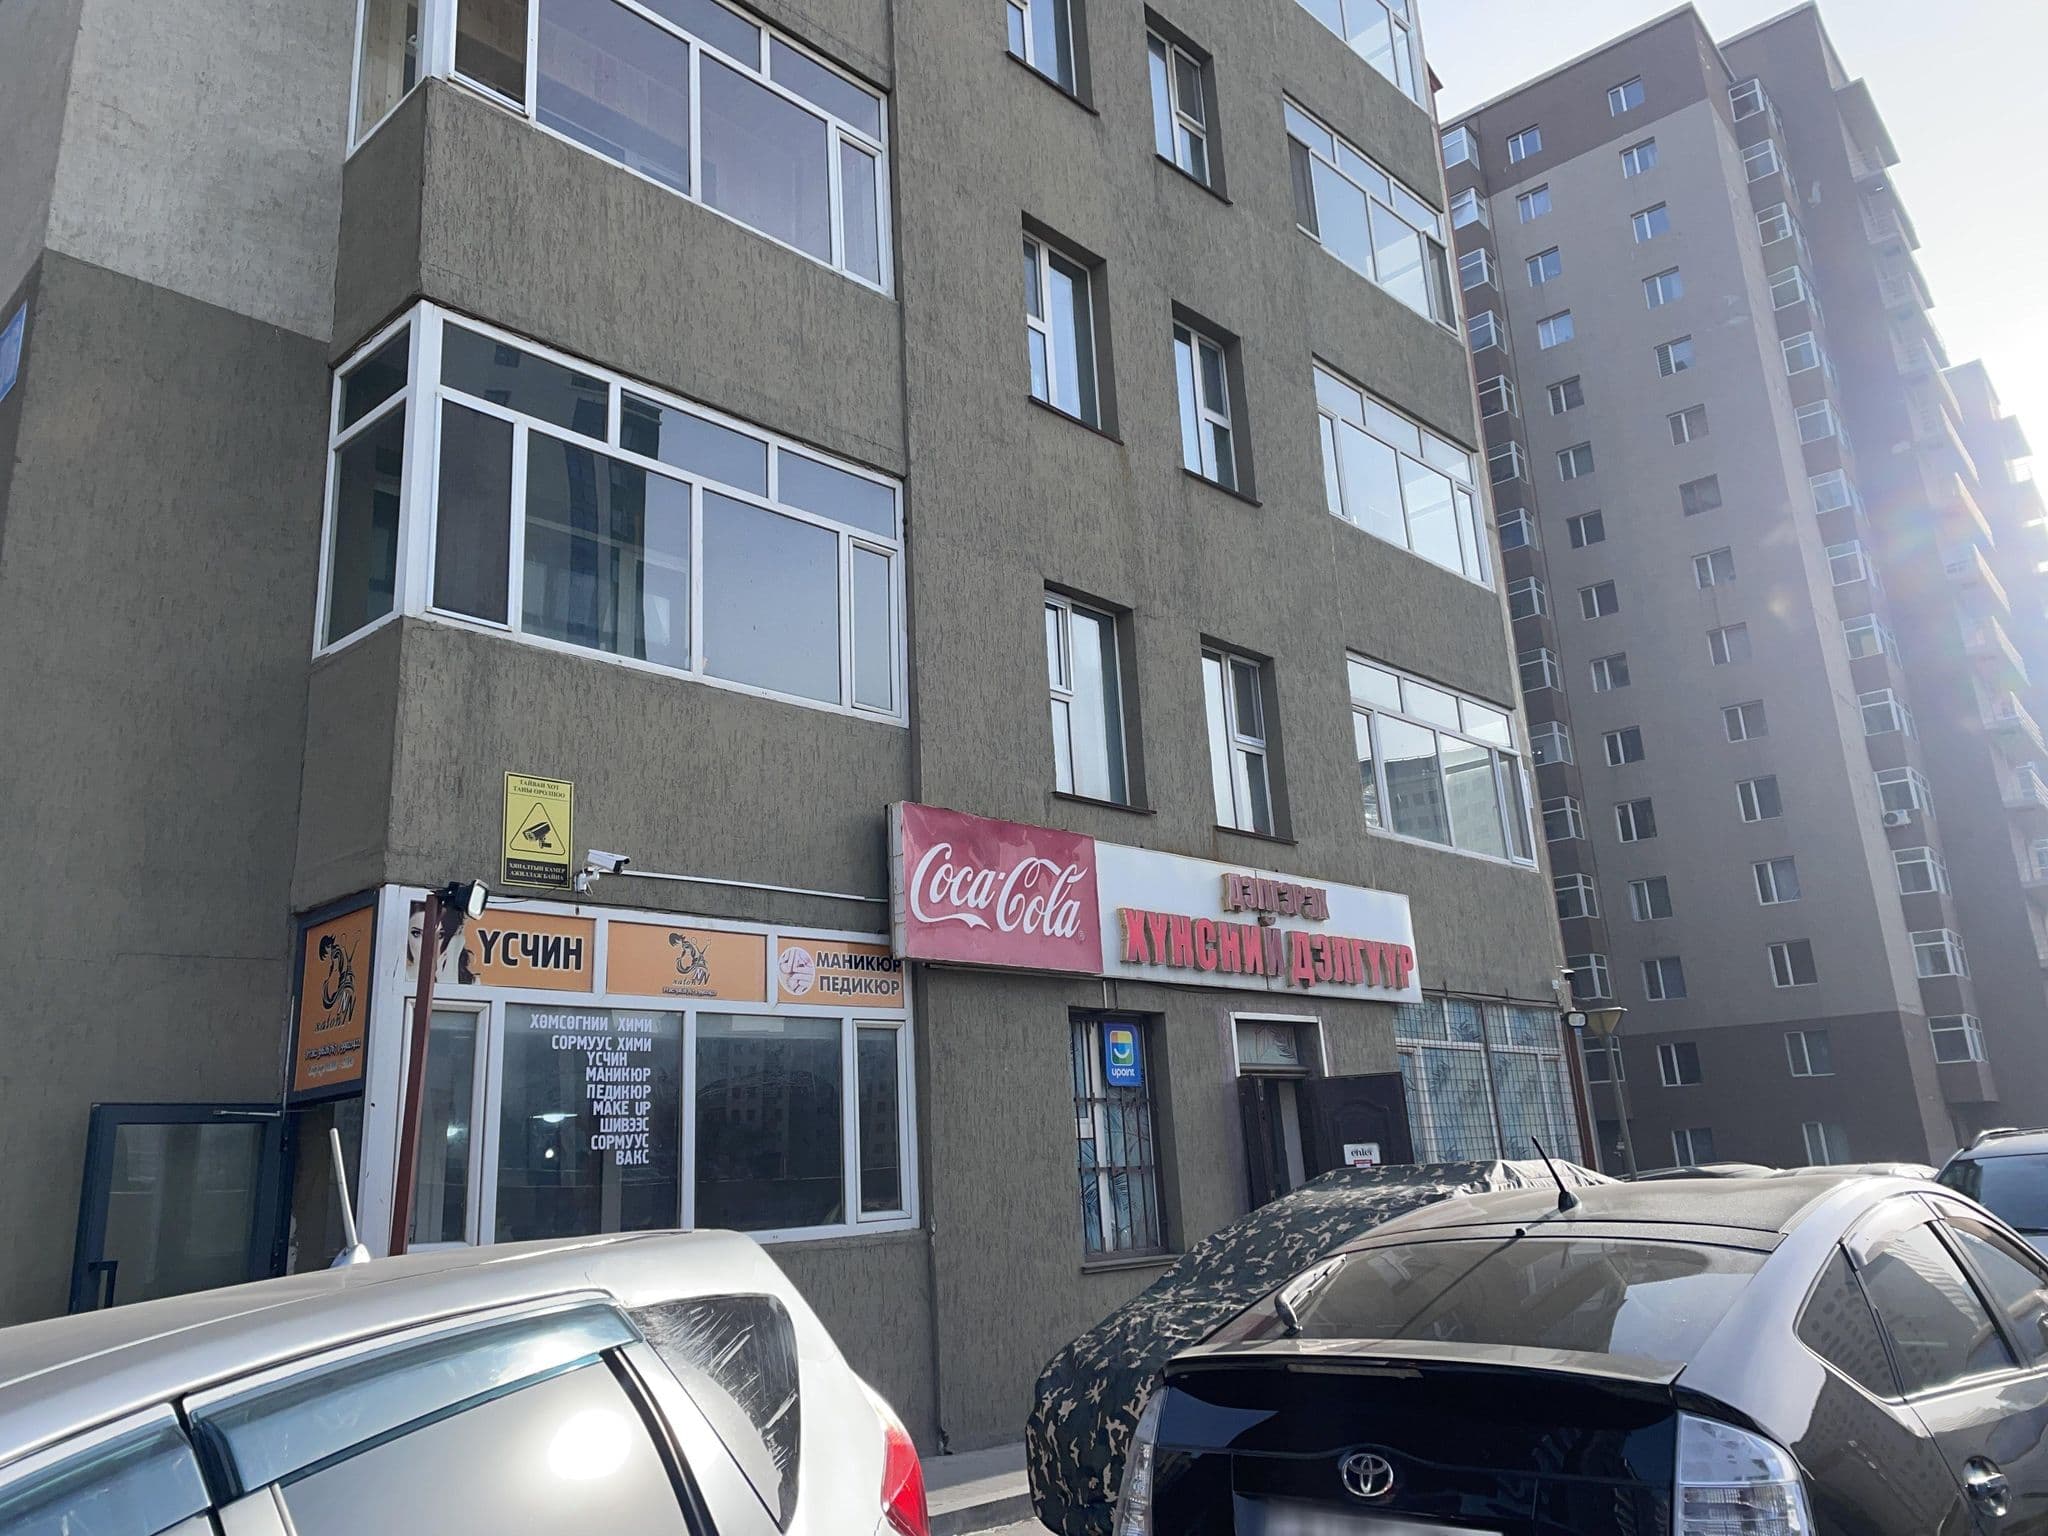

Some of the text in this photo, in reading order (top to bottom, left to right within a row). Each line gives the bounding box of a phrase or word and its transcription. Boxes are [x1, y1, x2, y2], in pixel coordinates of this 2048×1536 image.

[477, 929, 584, 971] ҮСЧИН
[815, 950, 902, 973] МАНИКЮР
[1286, 930, 1415, 990] ДЭЛГҮҮР
[818, 974, 901, 996] ПЕДИКЮР
[617, 1016, 652, 1033] ХИМИ
[552, 1035, 652, 1052] СОРМУУС ХИМИ
[586, 1051, 628, 1067] ҮСЧИН
[585, 1066, 651, 1082] МАНИКЮР
[586, 1083, 651, 1102] ПЕДИКЮР
[593, 1100, 652, 1116] MAKE UP
[600, 1117, 650, 1133] ШИВЭЭС
[591, 1133, 649, 1150] СОРМУУС
[615, 1149, 650, 1166] ВАКС
